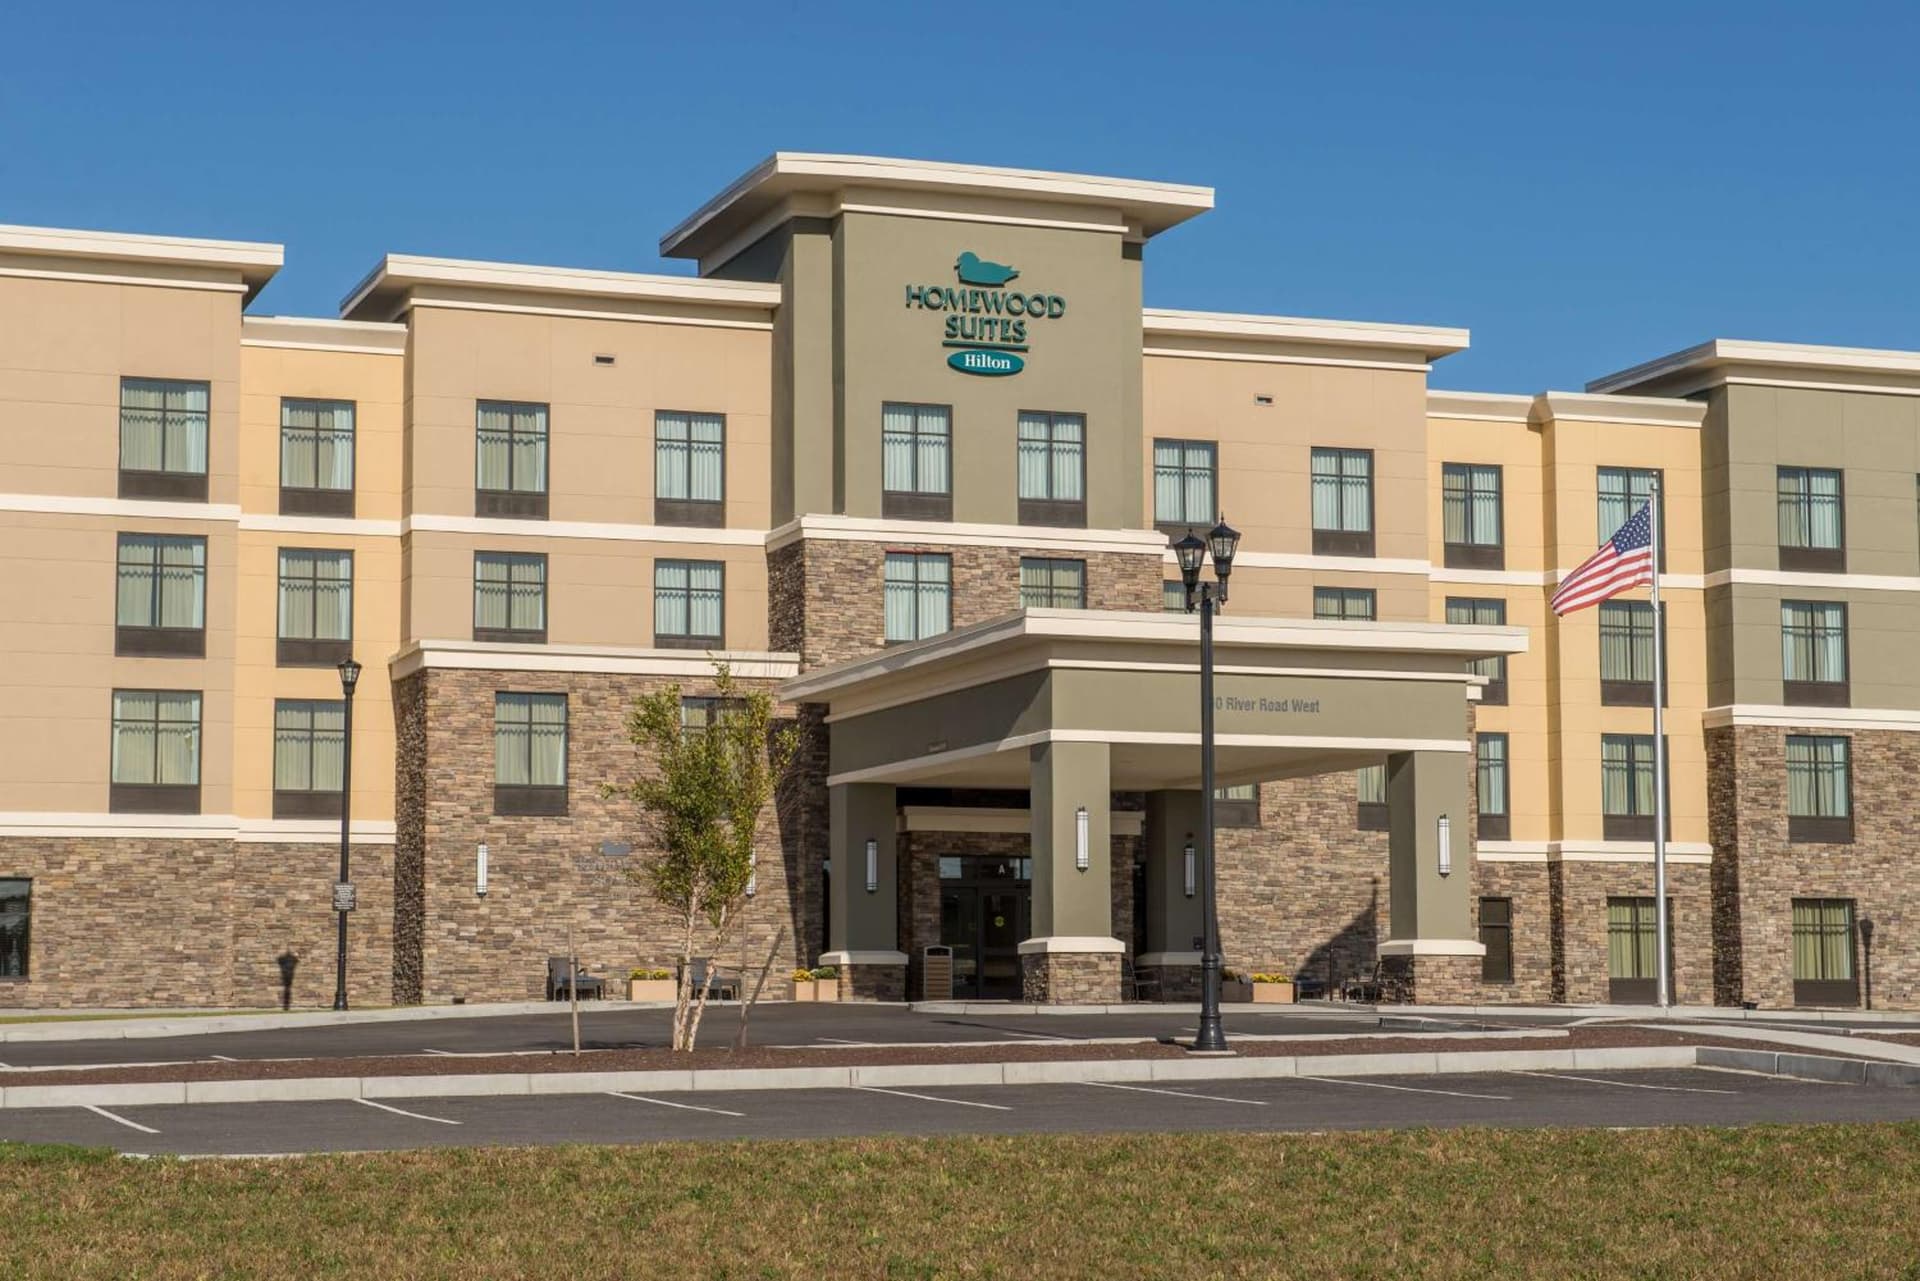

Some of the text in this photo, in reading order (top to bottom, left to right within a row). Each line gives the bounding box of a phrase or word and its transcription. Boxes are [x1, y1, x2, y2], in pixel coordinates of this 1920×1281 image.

[905, 284, 1066, 319] HOMEWOOD
[945, 314, 1027, 343] SUITES
[964, 354, 1011, 369] Hilton
[1226, 696, 1256, 711] River
[1259, 697, 1288, 712] Road
[1291, 698, 1320, 713] West
